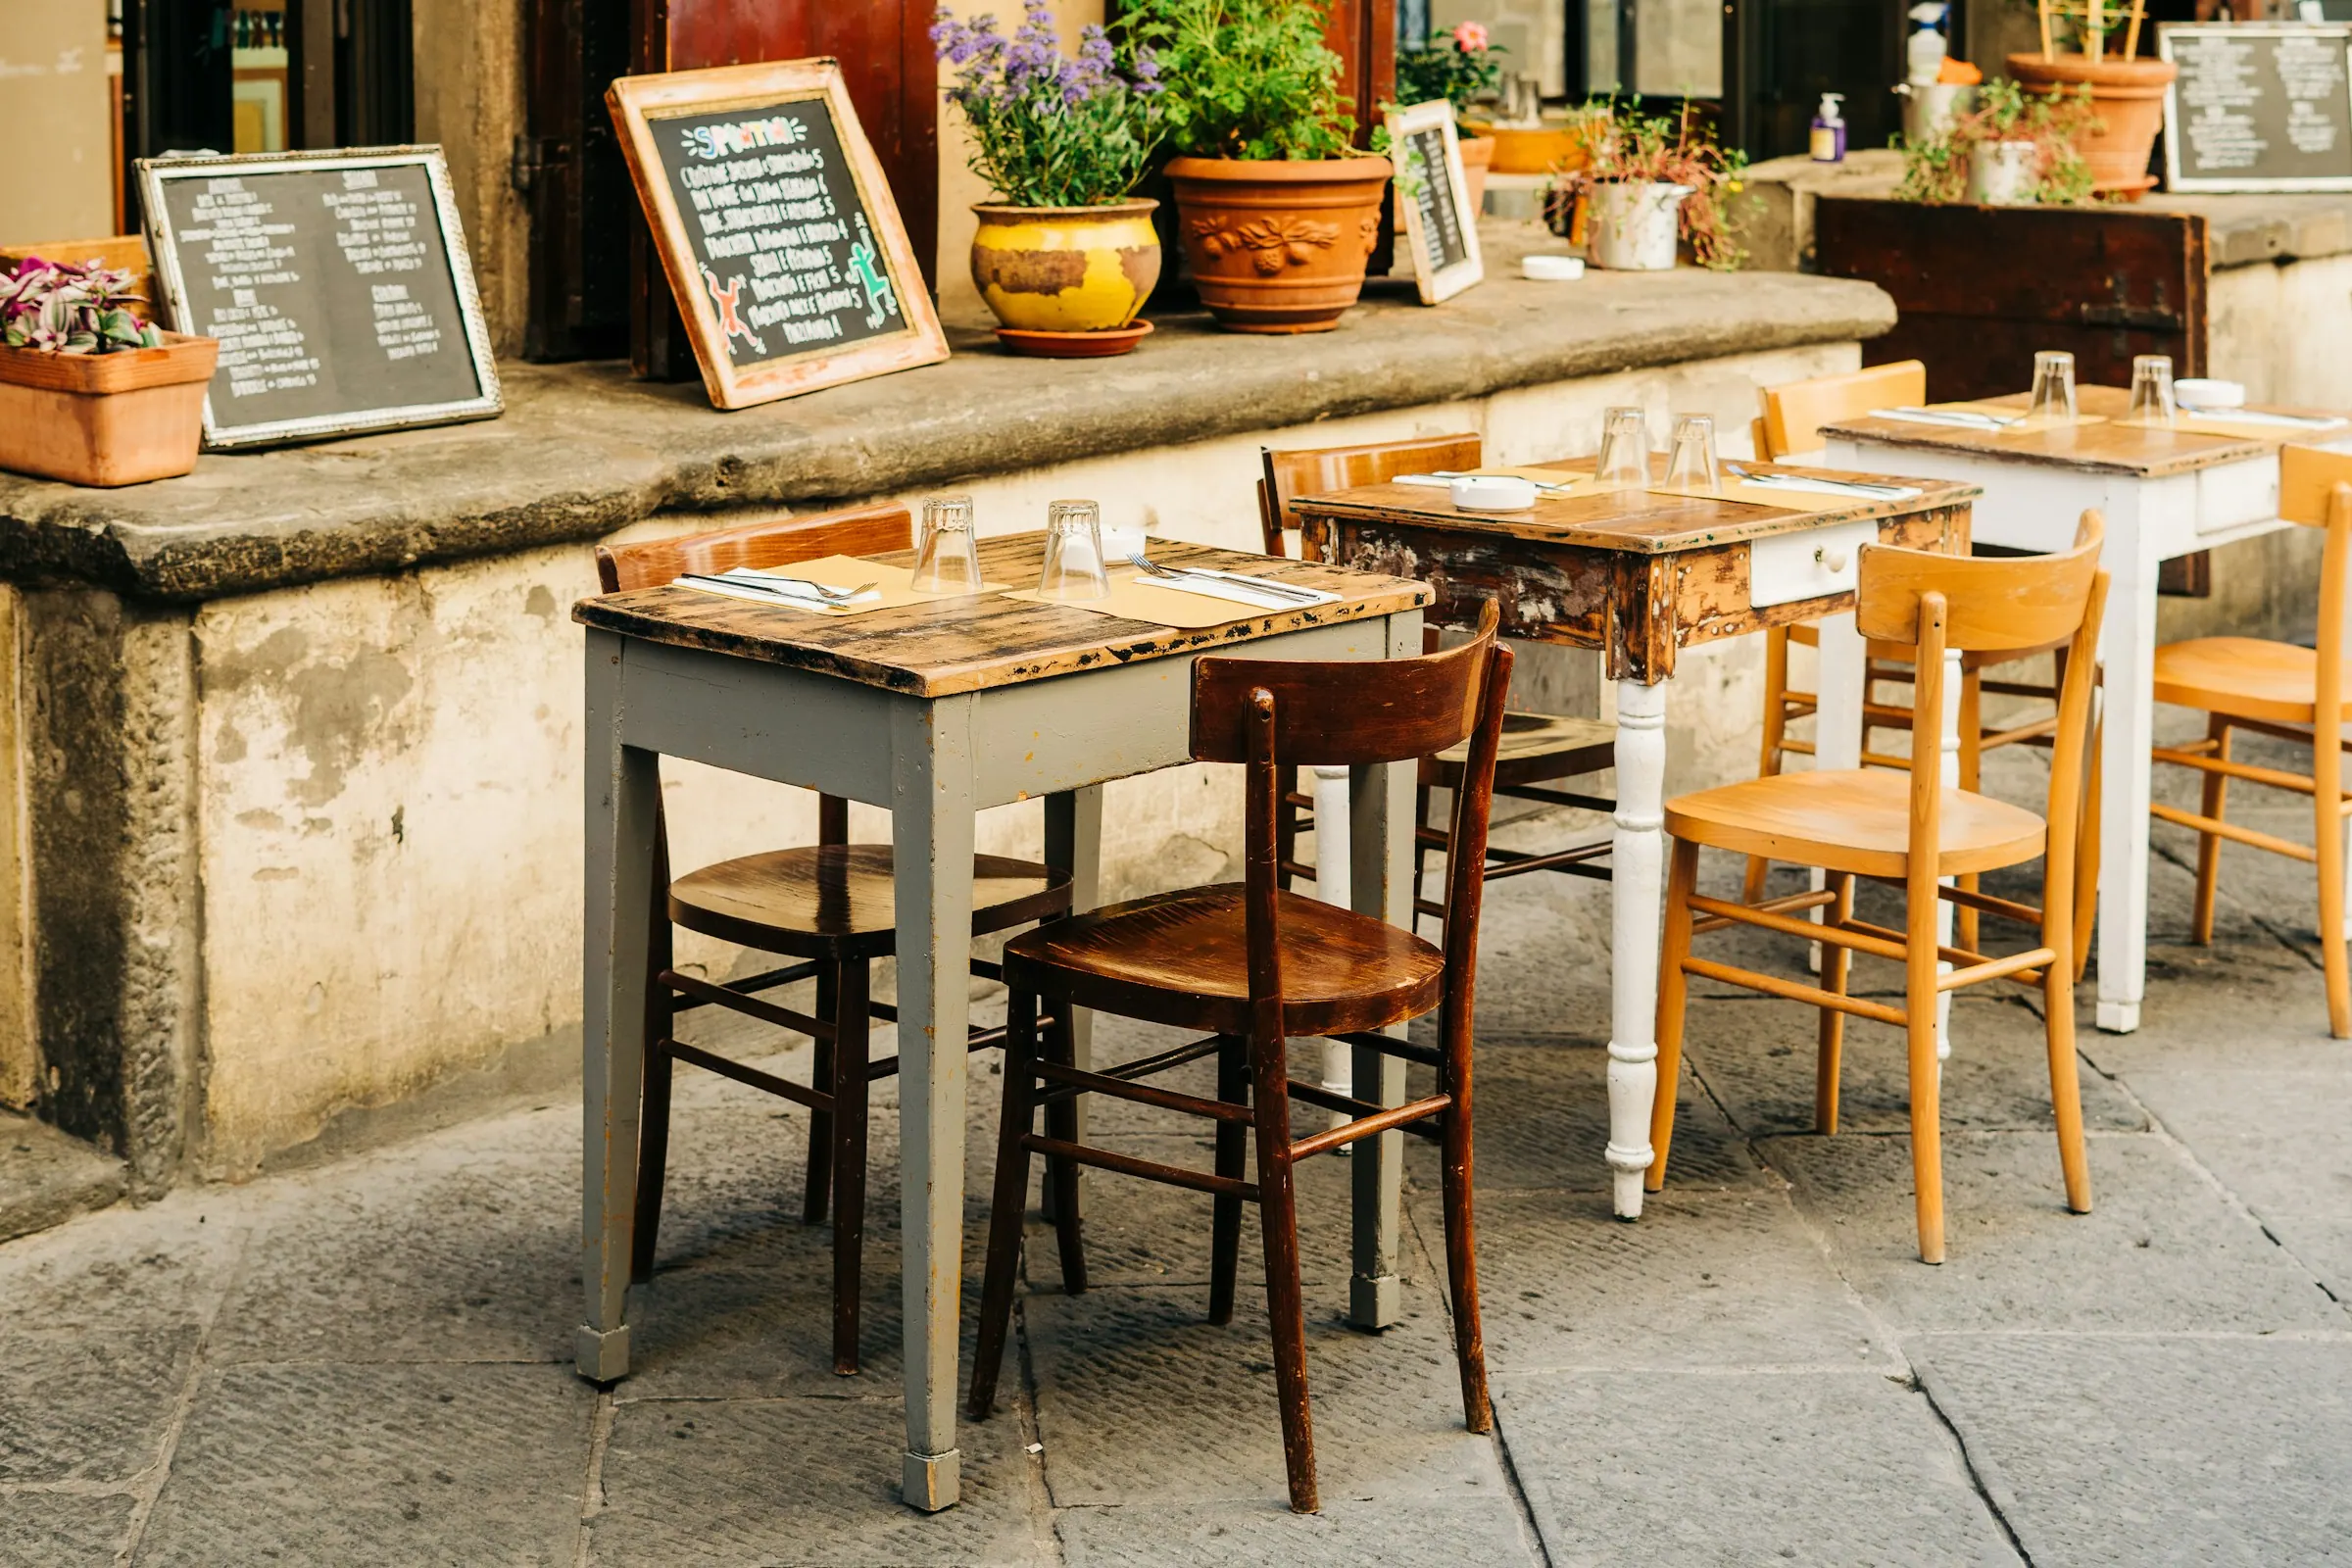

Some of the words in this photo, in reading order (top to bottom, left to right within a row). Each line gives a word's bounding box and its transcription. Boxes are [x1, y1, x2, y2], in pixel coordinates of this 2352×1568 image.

[811, 148, 823, 169] 5
[817, 172, 828, 194] 6
[778, 203, 790, 220] E
[823, 195, 835, 215] 5
[837, 218, 849, 239] 4
[777, 249, 789, 270] E
[821, 244, 833, 265] 5
[796, 273, 806, 292] E
[828, 265, 841, 283] 5
[806, 295, 816, 314] E
[848, 287, 862, 309] 5
[830, 314, 843, 336] 4
